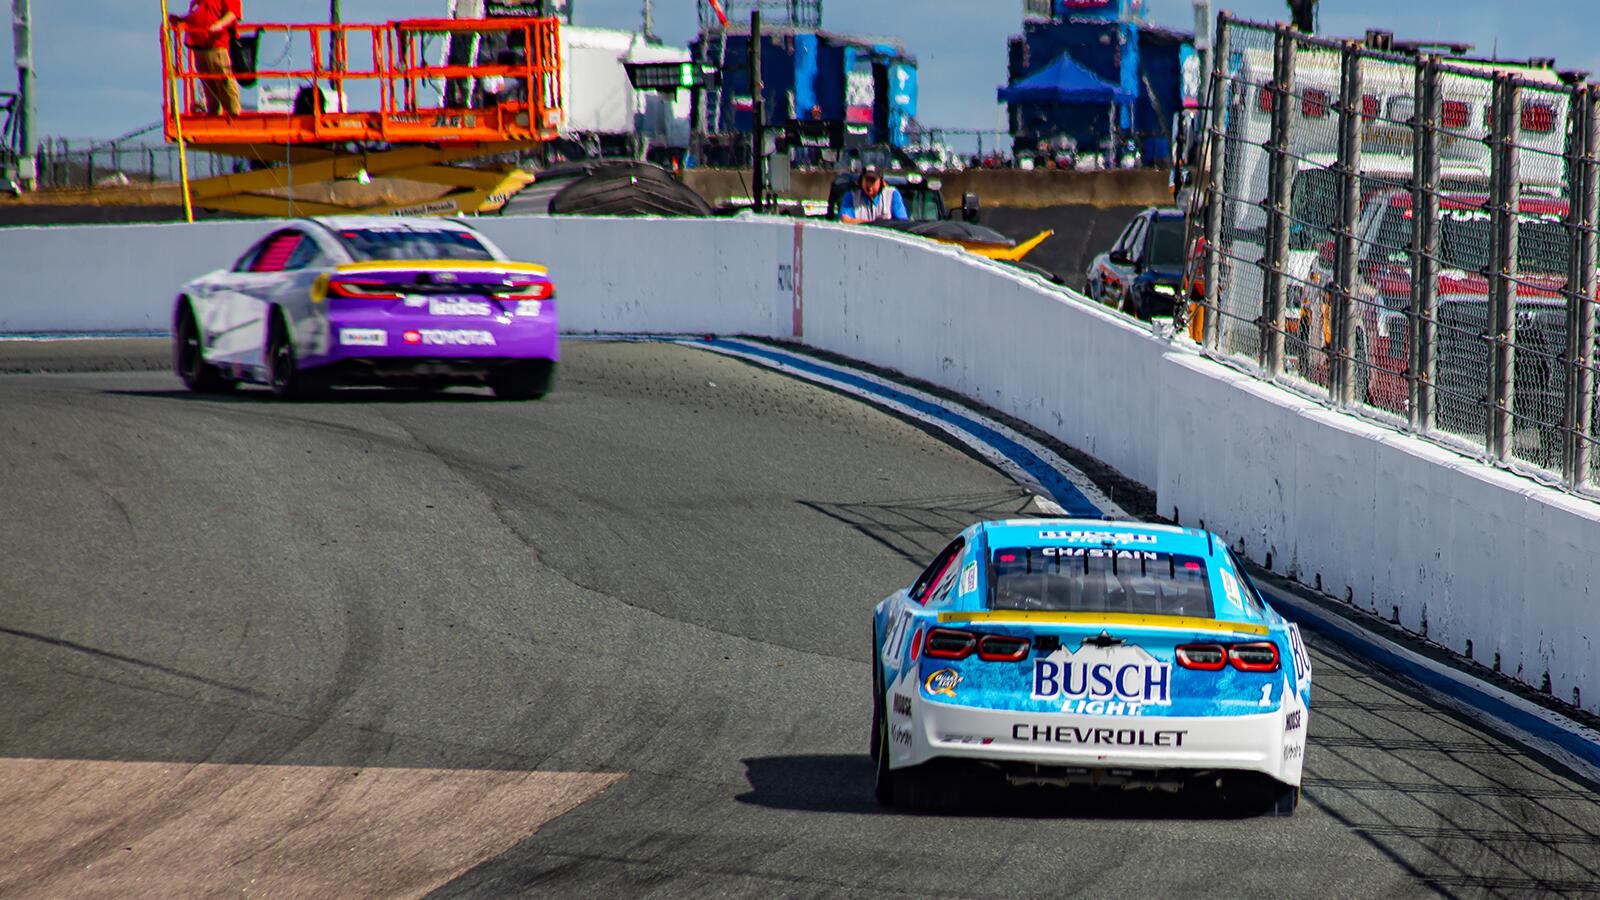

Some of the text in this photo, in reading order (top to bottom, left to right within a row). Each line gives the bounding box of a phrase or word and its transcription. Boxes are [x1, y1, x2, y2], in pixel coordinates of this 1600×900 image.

[419, 329, 496, 346] TOYOTA
[1042, 547, 1158, 560] CHASTAIN
[1033, 659, 1169, 702] BUSCH
[1258, 683, 1273, 706] 1
[1061, 700, 1141, 717] LIGHT
[1012, 723, 1189, 748] CHEVROLET
